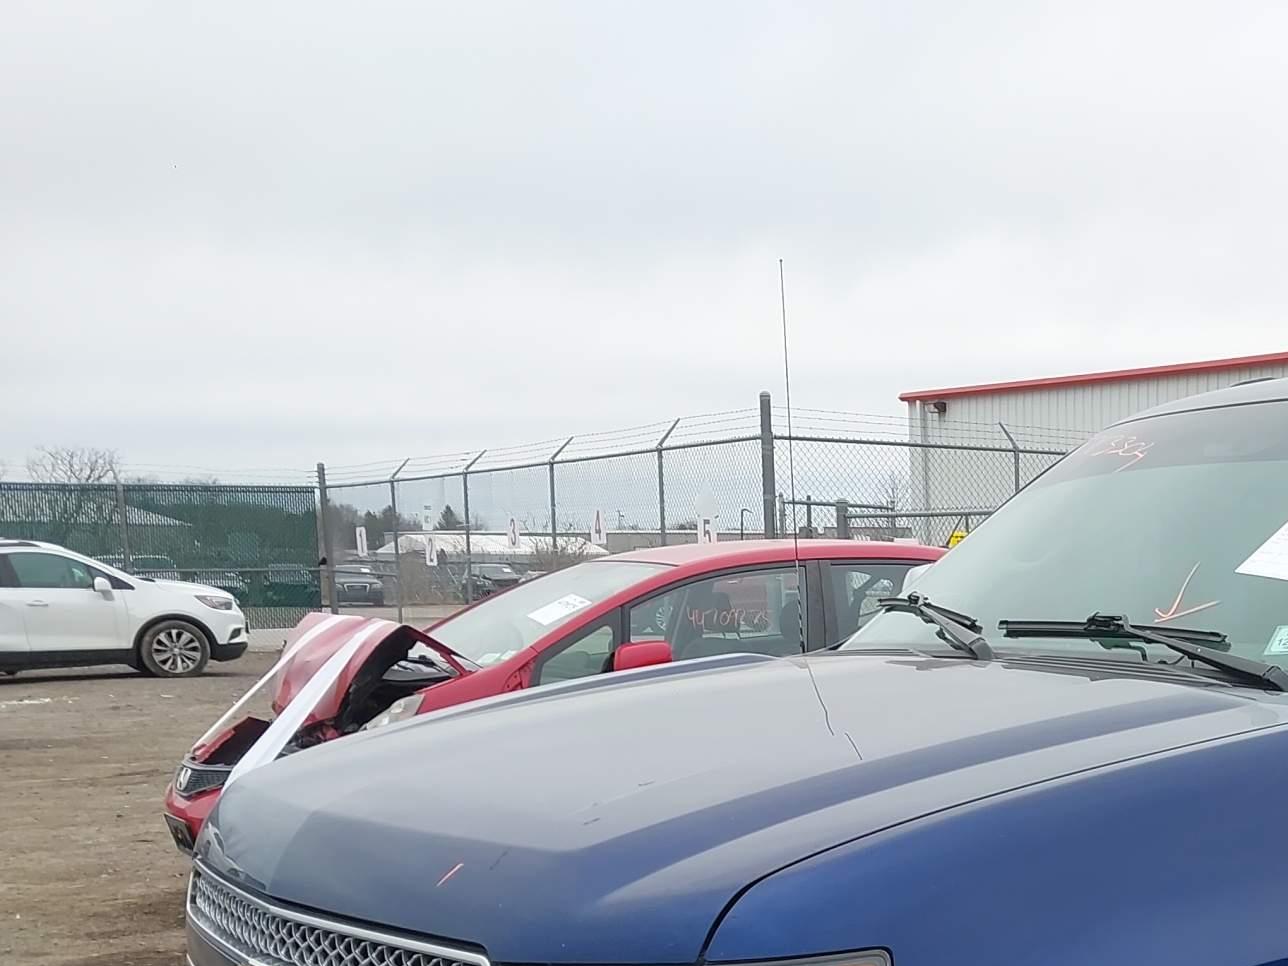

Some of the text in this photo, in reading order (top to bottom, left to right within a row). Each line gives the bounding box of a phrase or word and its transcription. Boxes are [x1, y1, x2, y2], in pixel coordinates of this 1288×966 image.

[509, 518, 517, 546] 3
[594, 510, 602, 541] 4
[703, 519, 712, 544] 5
[428, 537, 435, 563] 2
